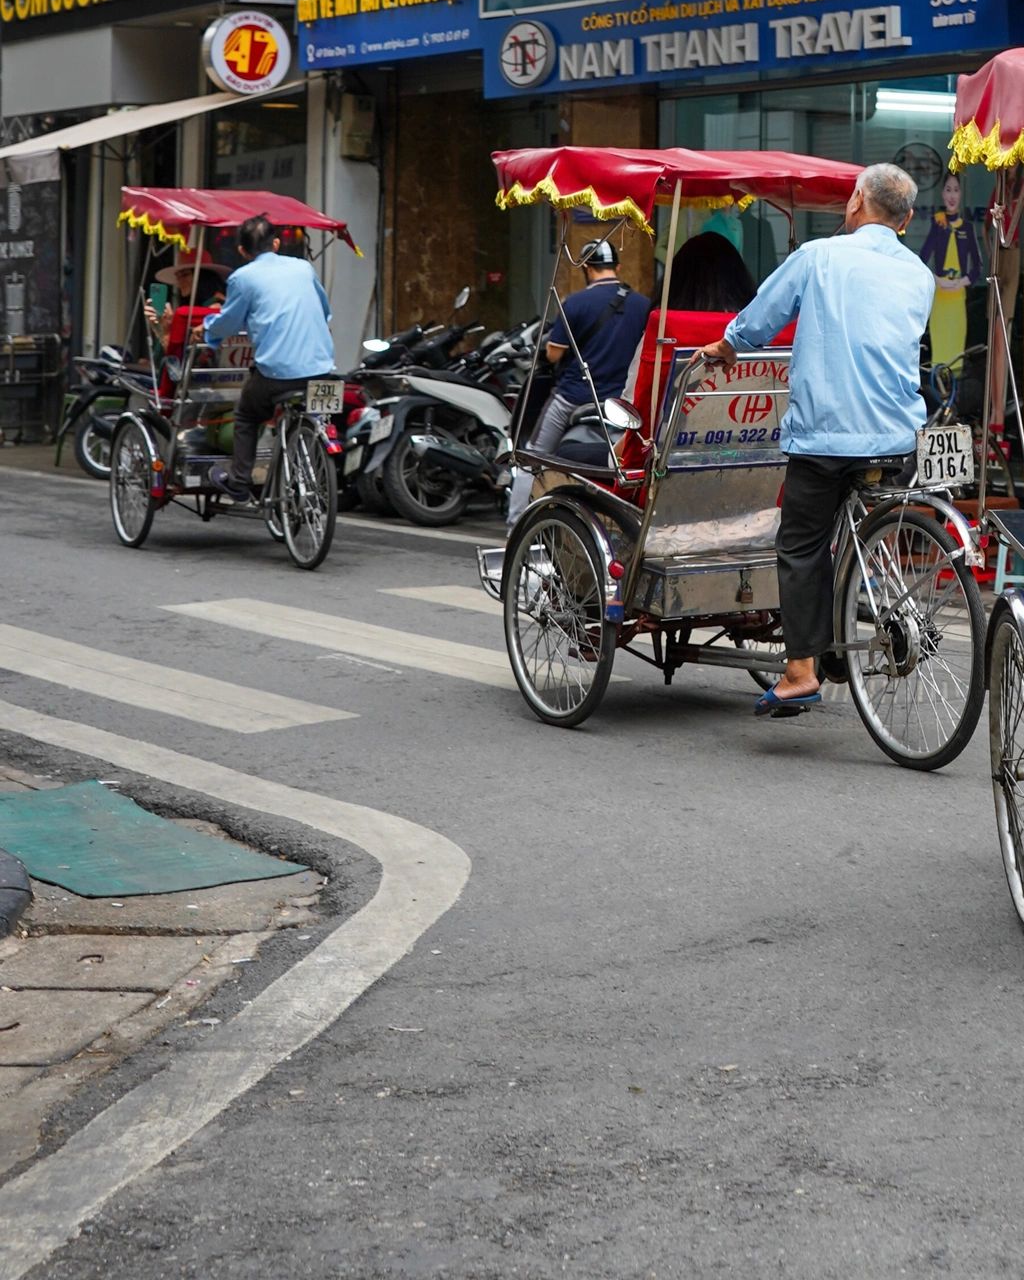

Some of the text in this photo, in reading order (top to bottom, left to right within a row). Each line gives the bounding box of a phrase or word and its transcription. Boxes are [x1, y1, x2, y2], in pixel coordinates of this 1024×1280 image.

[582, 12, 614, 31] CÔNG
[614, 11, 630, 28] TY
[630, 0, 648, 25] CỔ
[680, 2, 698, 19] DU
[558, 38, 634, 82] NAM
[640, 22, 761, 72] THANH
[768, 5, 913, 59] TRAVEL
[314, 383, 337, 397] 29XL
[681, 373, 718, 416] HUY
[311, 399, 340, 410] 0143
[704, 429, 733, 446] 091
[738, 427, 767, 443] 322
[928, 433, 963, 455] 29XL
[923, 455, 968, 479] 0164
